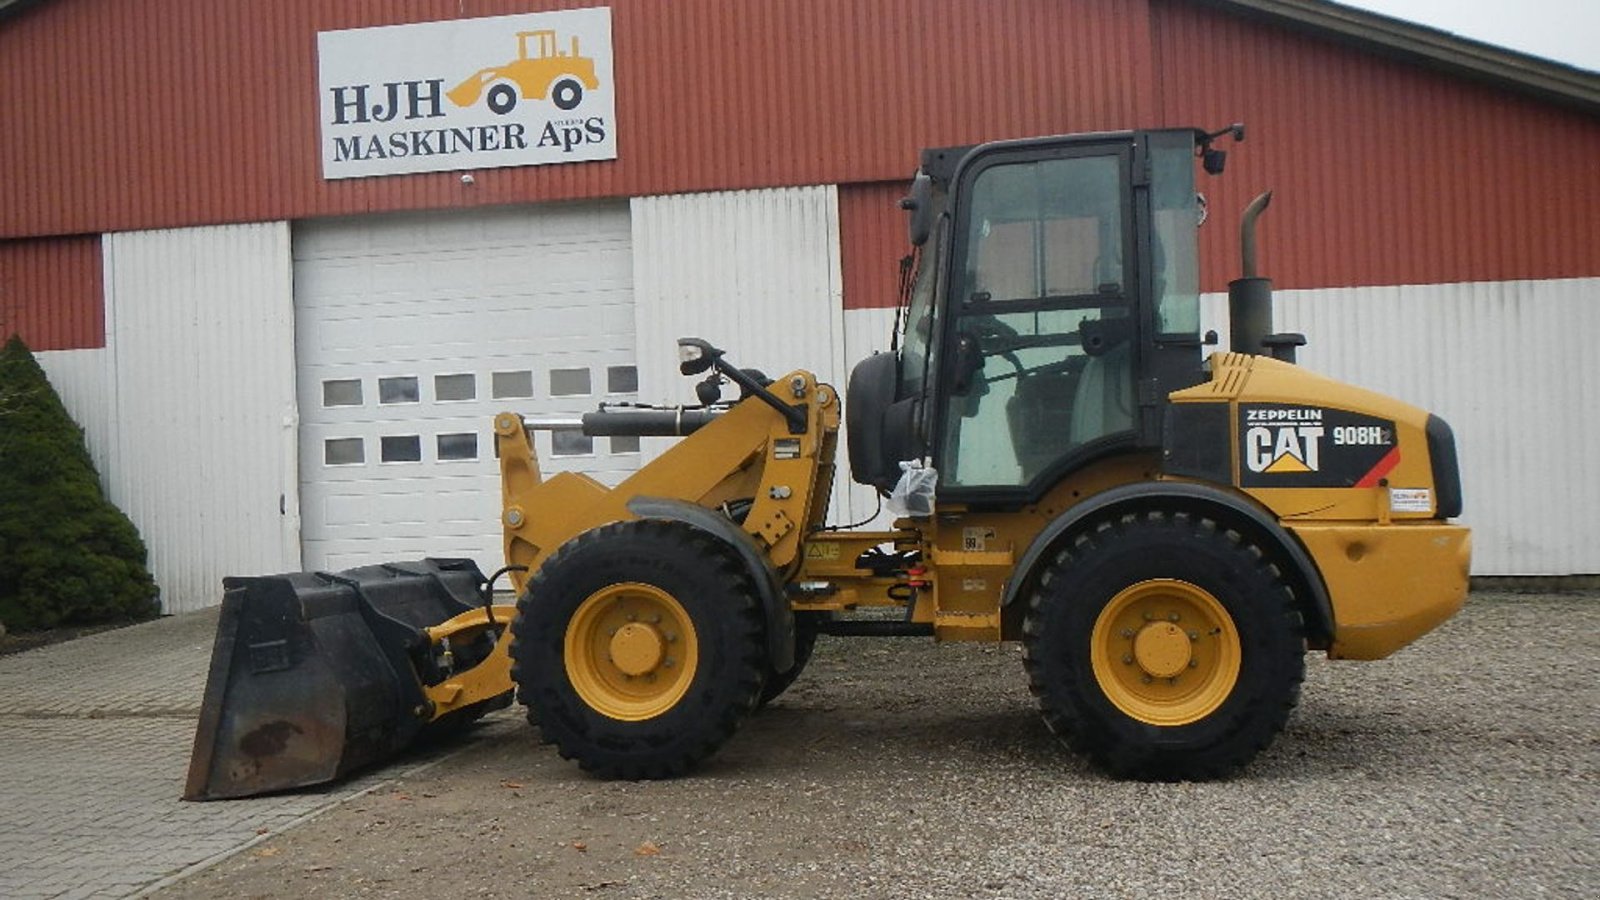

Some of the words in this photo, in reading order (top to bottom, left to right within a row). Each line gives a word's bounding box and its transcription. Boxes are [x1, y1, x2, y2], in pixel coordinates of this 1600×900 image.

[330, 79, 446, 125] HJH
[333, 123, 527, 162] MASKINER
[537, 117, 605, 152] ApS
[1247, 409, 1322, 420] ZEPPELIN
[1246, 426, 1324, 473] CAT
